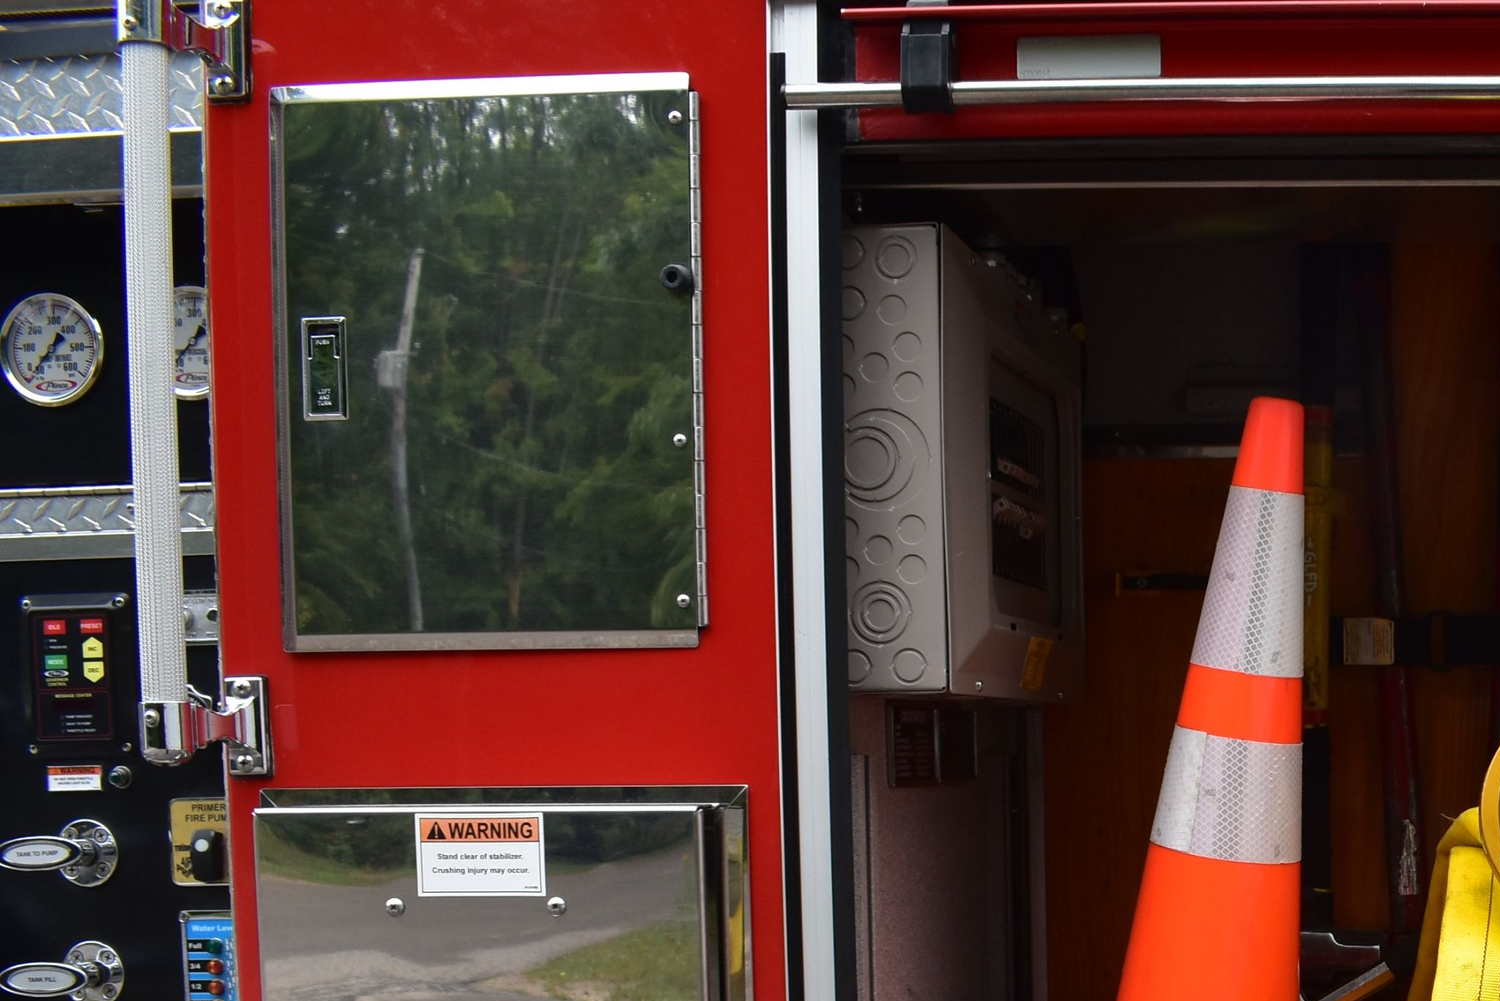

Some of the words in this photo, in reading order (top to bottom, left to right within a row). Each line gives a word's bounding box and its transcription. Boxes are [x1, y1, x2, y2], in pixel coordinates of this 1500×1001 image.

[46, 316, 61, 325] 300
[28, 326, 42, 335] 200
[61, 325, 76, 334] 400
[23, 343, 36, 352] 100
[70, 343, 85, 352] 500
[63, 362, 78, 372] 600
[60, 767, 95, 775] WARNING
[191, 803, 226, 812] PRIMER
[185, 814, 206, 822] FIRE
[208, 814, 227, 822] PUM
[448, 822, 533, 839] WARNING
[489, 852, 524, 860] stabilizer.
[432, 867, 465, 875] Crushing
[467, 867, 488, 875] injury
